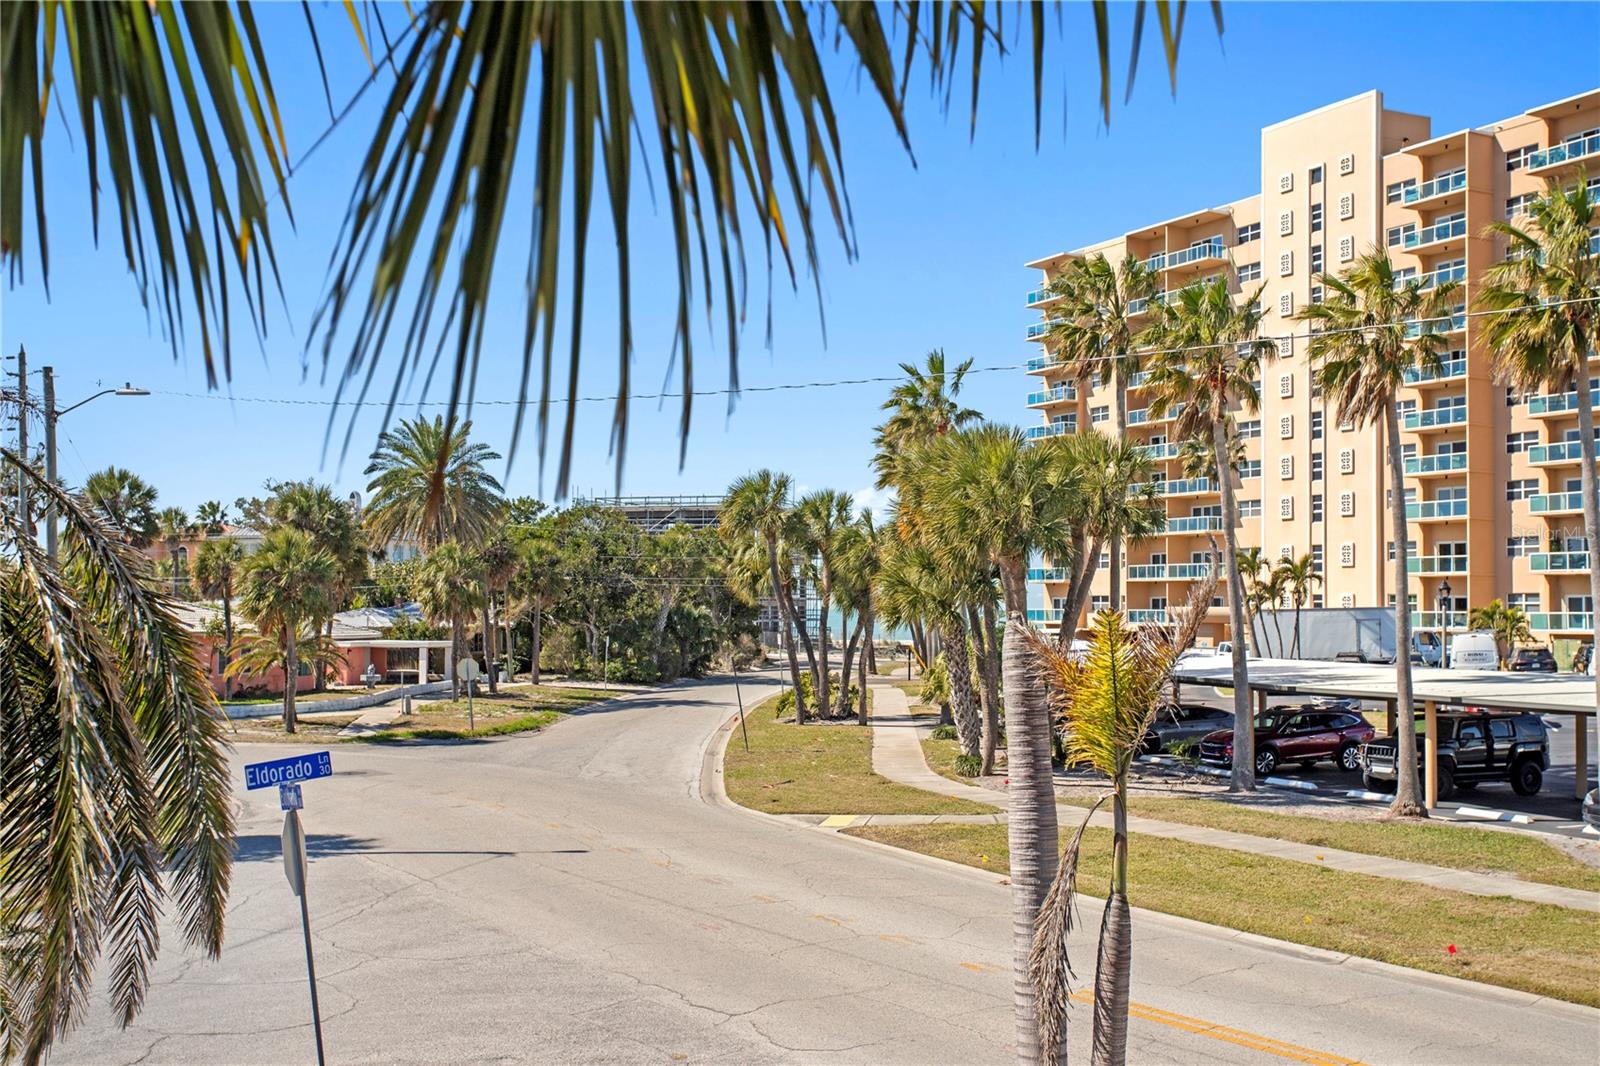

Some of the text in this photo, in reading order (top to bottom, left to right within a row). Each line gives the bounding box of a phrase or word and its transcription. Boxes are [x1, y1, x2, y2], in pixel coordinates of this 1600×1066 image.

[246, 755, 329, 786] Eldorado Ln
[319, 765, 331, 775] 30
